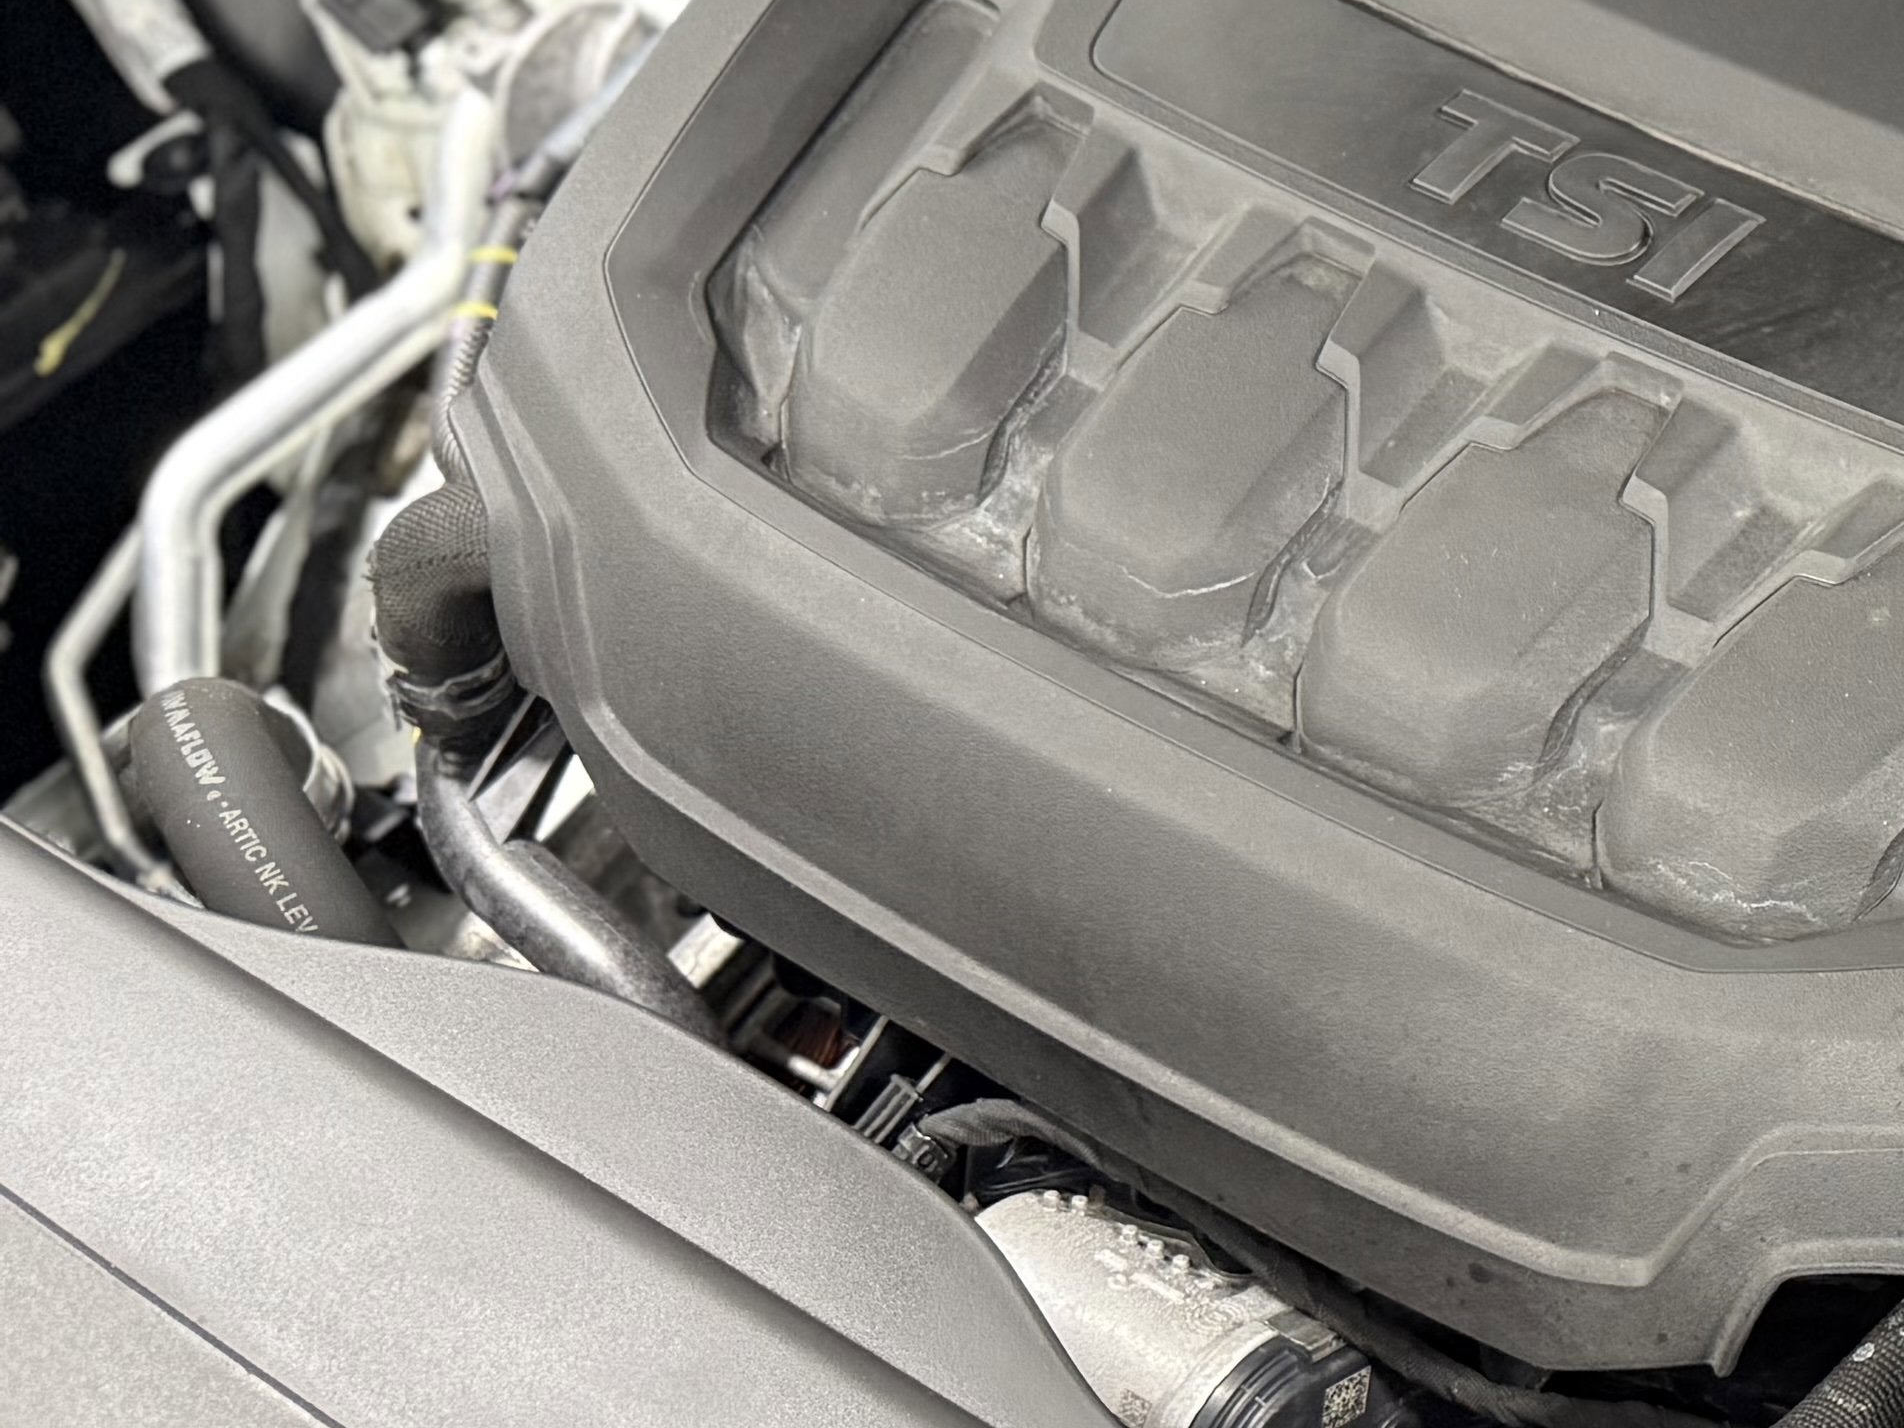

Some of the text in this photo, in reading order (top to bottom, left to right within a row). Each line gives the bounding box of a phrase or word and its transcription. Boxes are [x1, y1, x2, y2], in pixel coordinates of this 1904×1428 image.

[1408, 87, 1765, 303] TSI
[217, 808, 267, 862] ARTIC
[253, 861, 289, 895] NK
